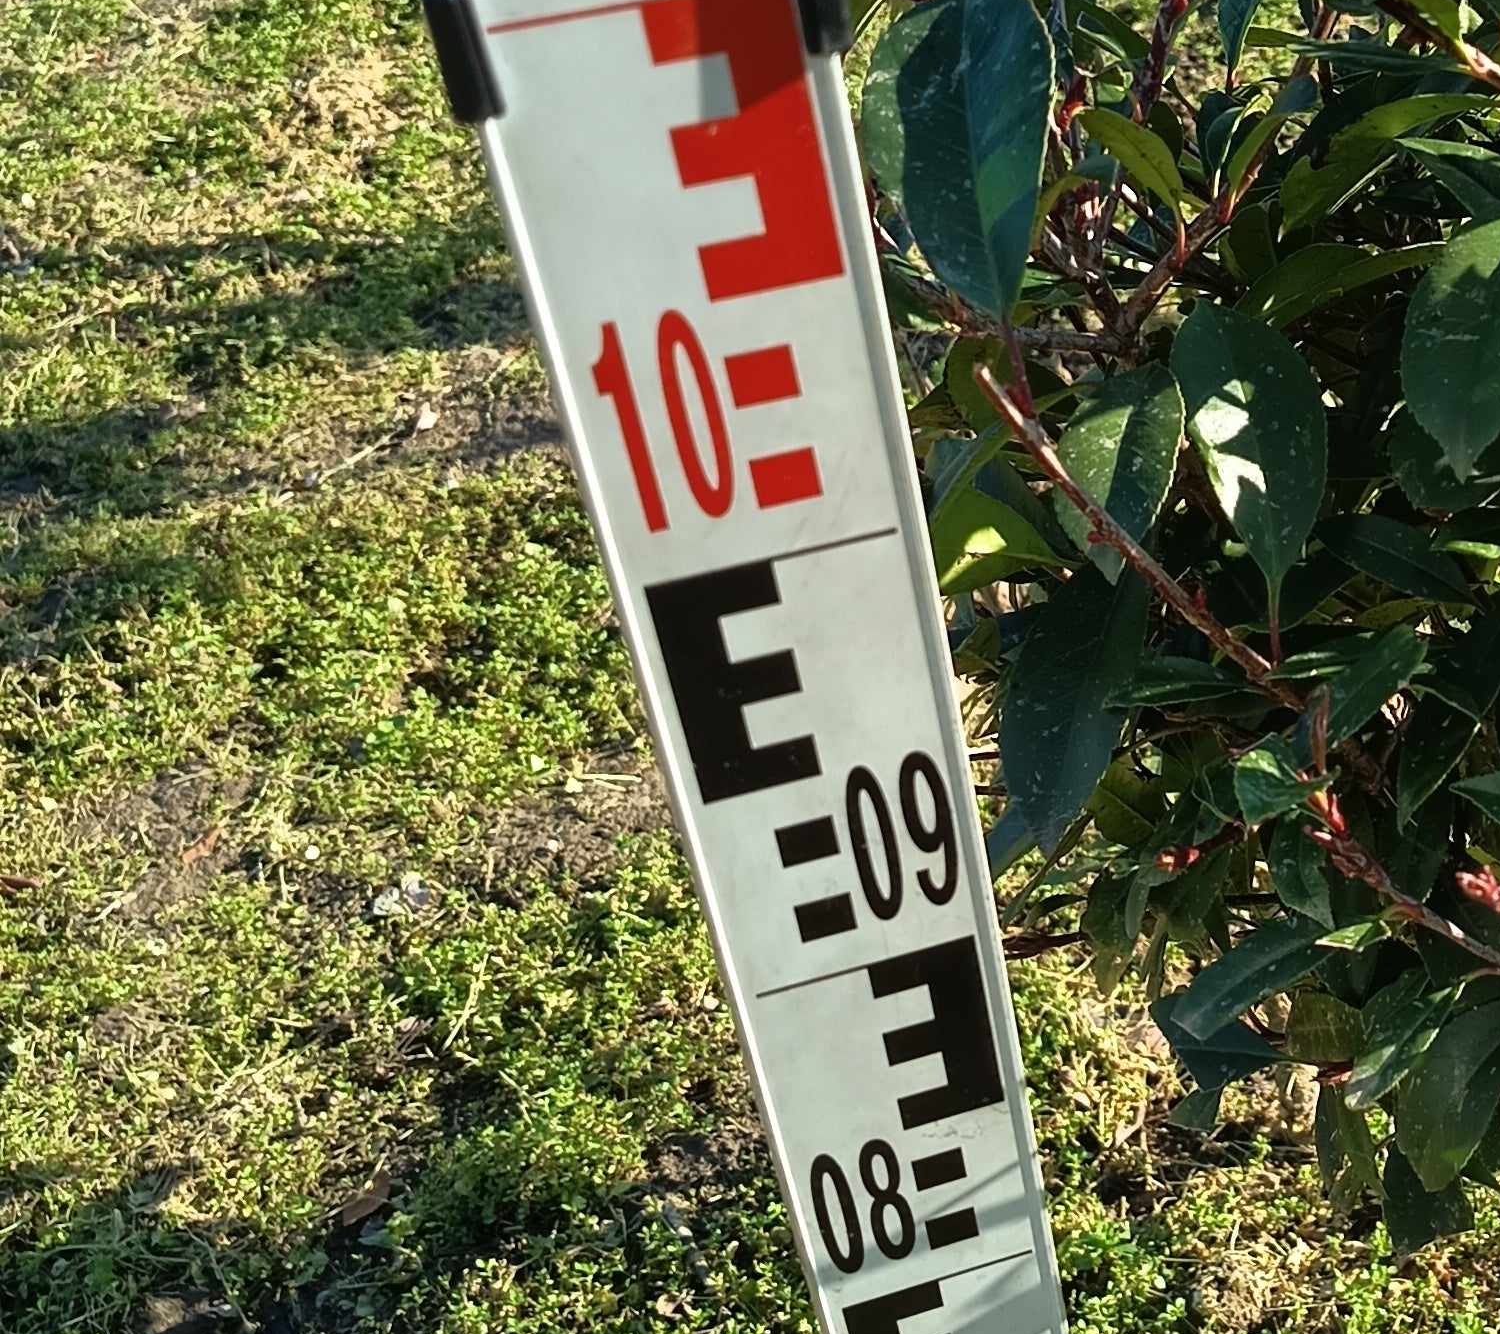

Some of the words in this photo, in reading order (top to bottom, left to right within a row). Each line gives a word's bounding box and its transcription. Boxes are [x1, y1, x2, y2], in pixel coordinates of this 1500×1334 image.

[592, 309, 735, 535] 10
[845, 750, 959, 921] 09
[810, 1139, 917, 1274] 08
